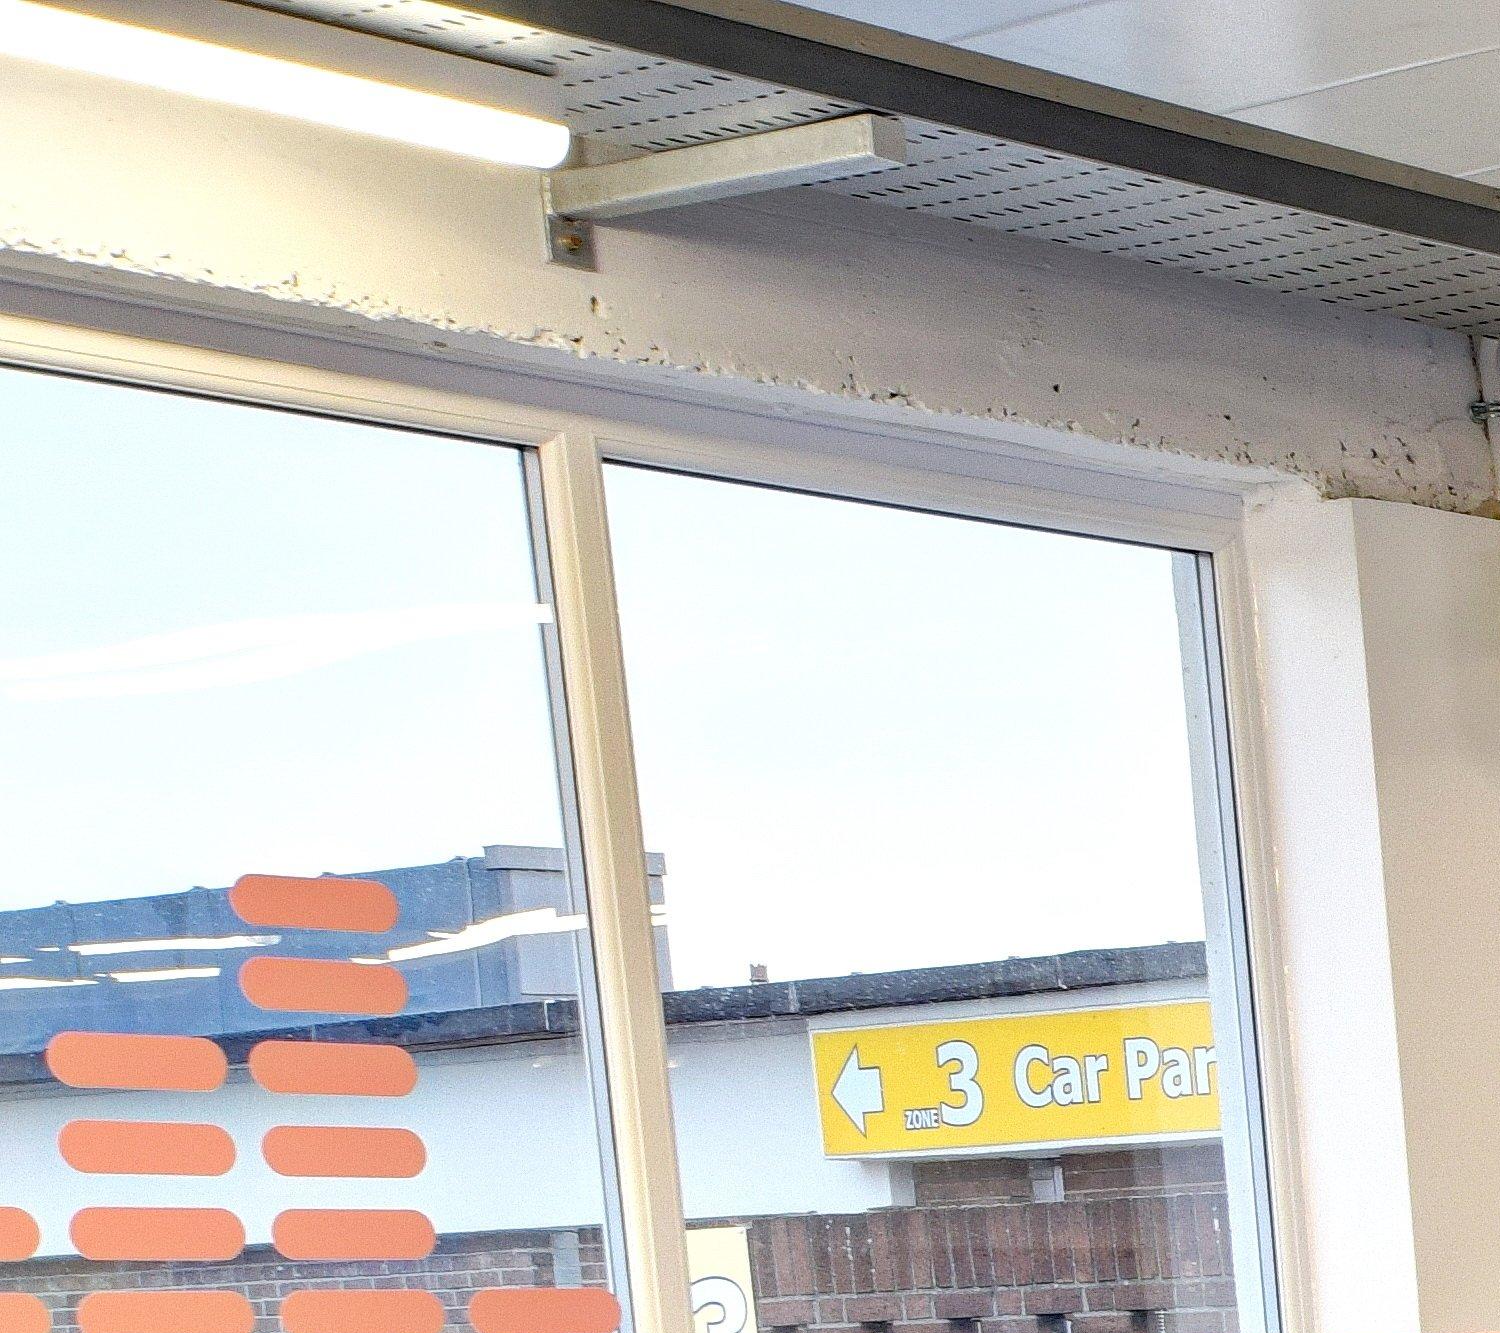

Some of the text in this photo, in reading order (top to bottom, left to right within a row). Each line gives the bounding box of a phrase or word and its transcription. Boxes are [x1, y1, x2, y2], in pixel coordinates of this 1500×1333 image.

[904, 1108, 940, 1131] ZONE
[935, 1039, 985, 1127] 3
[1013, 1043, 1109, 1108] Car
